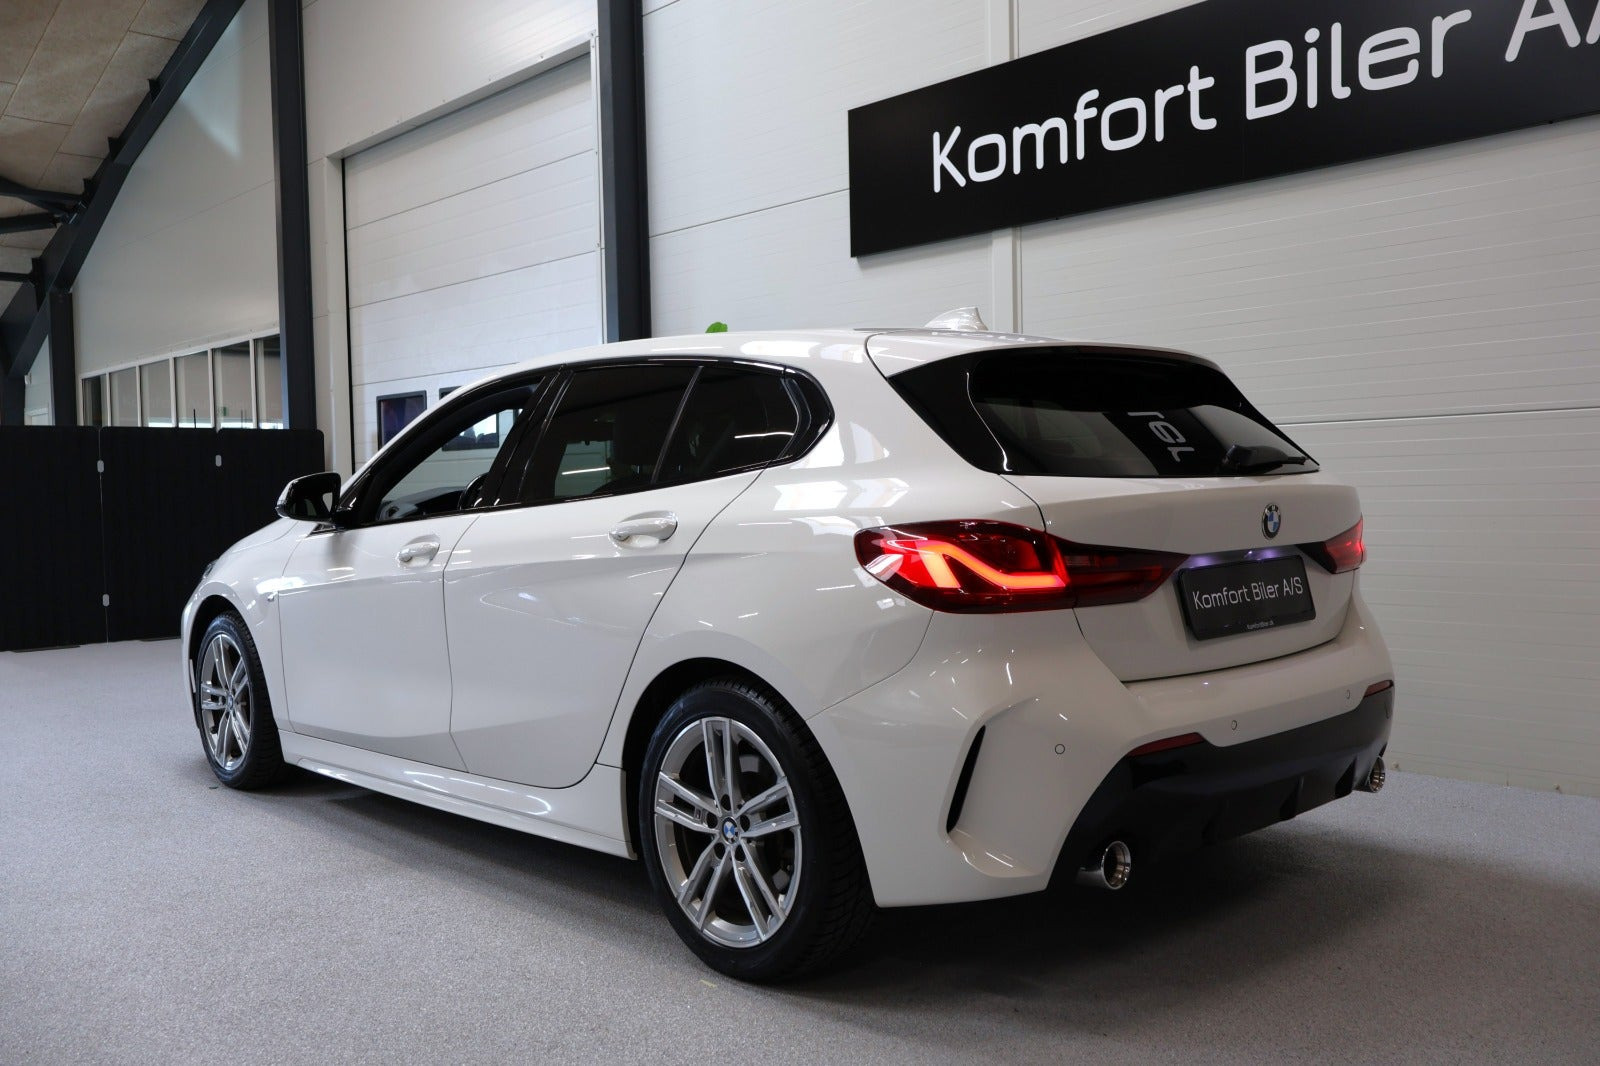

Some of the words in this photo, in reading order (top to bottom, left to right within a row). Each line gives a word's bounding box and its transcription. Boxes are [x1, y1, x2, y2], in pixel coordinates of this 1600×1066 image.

[933, 65, 1217, 194] Komfort
[1245, 9, 1473, 121] Biler
[1192, 586, 1250, 610] Komfort
[1251, 581, 1279, 601] Biler
[1283, 577, 1303, 596] A/S
